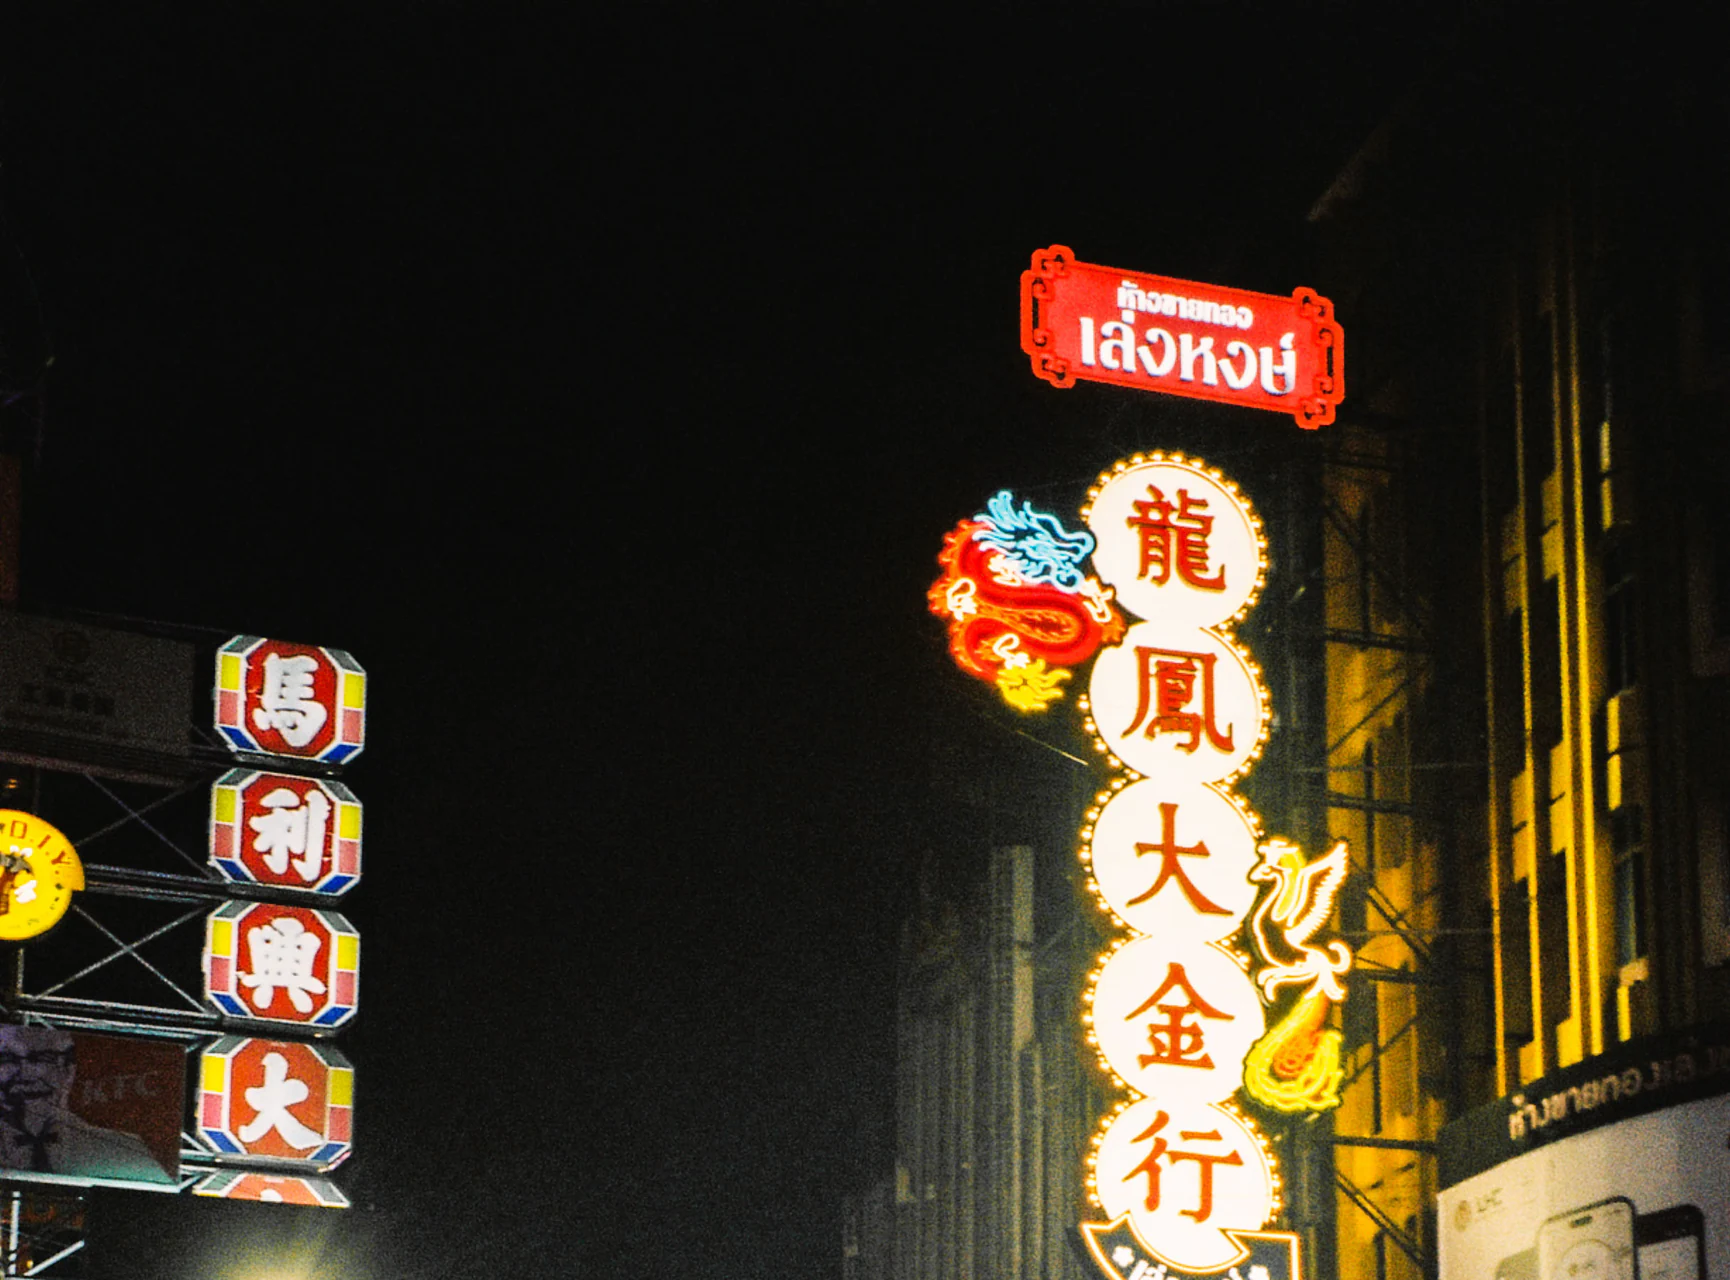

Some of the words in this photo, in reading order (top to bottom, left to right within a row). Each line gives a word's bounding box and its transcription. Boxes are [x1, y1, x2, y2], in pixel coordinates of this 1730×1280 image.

[1117, 279, 1254, 331] ห้างขายทอง
[1079, 309, 1297, 396] เล่งหงษ์
[1121, 484, 1246, 1225] 龍鳳大金行
